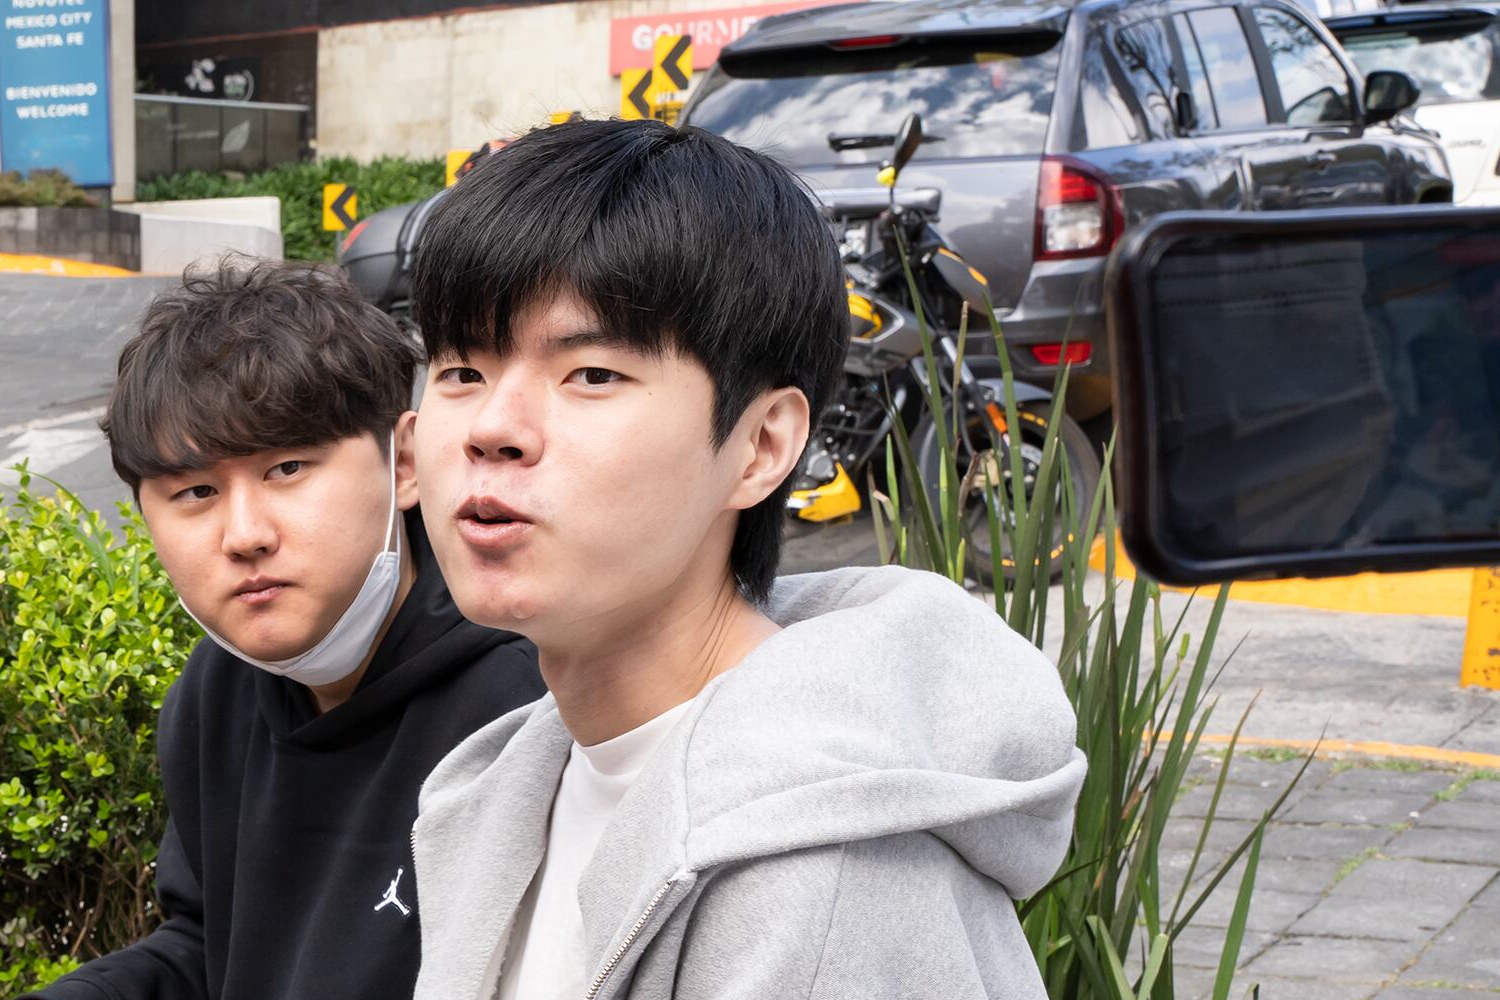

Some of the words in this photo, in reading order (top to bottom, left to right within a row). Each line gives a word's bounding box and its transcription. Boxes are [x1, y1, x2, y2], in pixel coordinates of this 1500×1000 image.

[5, 14, 57, 30] MEXICO
[60, 12, 92, 27] CITY
[16, 33, 63, 49] SANTA
[66, 32, 84, 46] FE
[6, 82, 97, 100] BIENVENIDO
[16, 102, 89, 119] WELCOME
